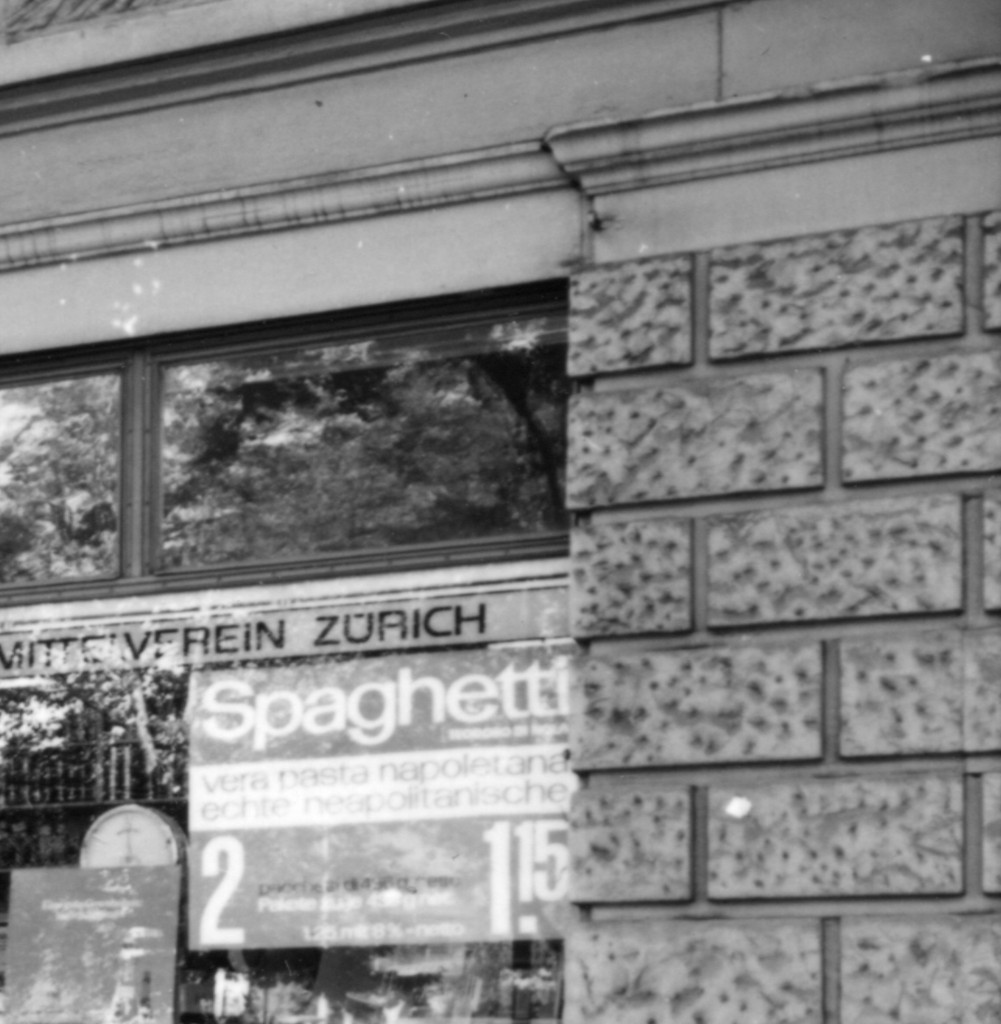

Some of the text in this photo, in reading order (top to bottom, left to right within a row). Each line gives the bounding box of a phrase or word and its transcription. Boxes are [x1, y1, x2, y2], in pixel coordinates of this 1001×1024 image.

[313, 602, 487, 647] ZÜRICH
[201, 655, 571, 752] Spaghetti
[201, 752, 569, 793] vera pasta napoletana
[201, 778, 568, 821] echte neapolitanische
[200, 835, 246, 945] 2
